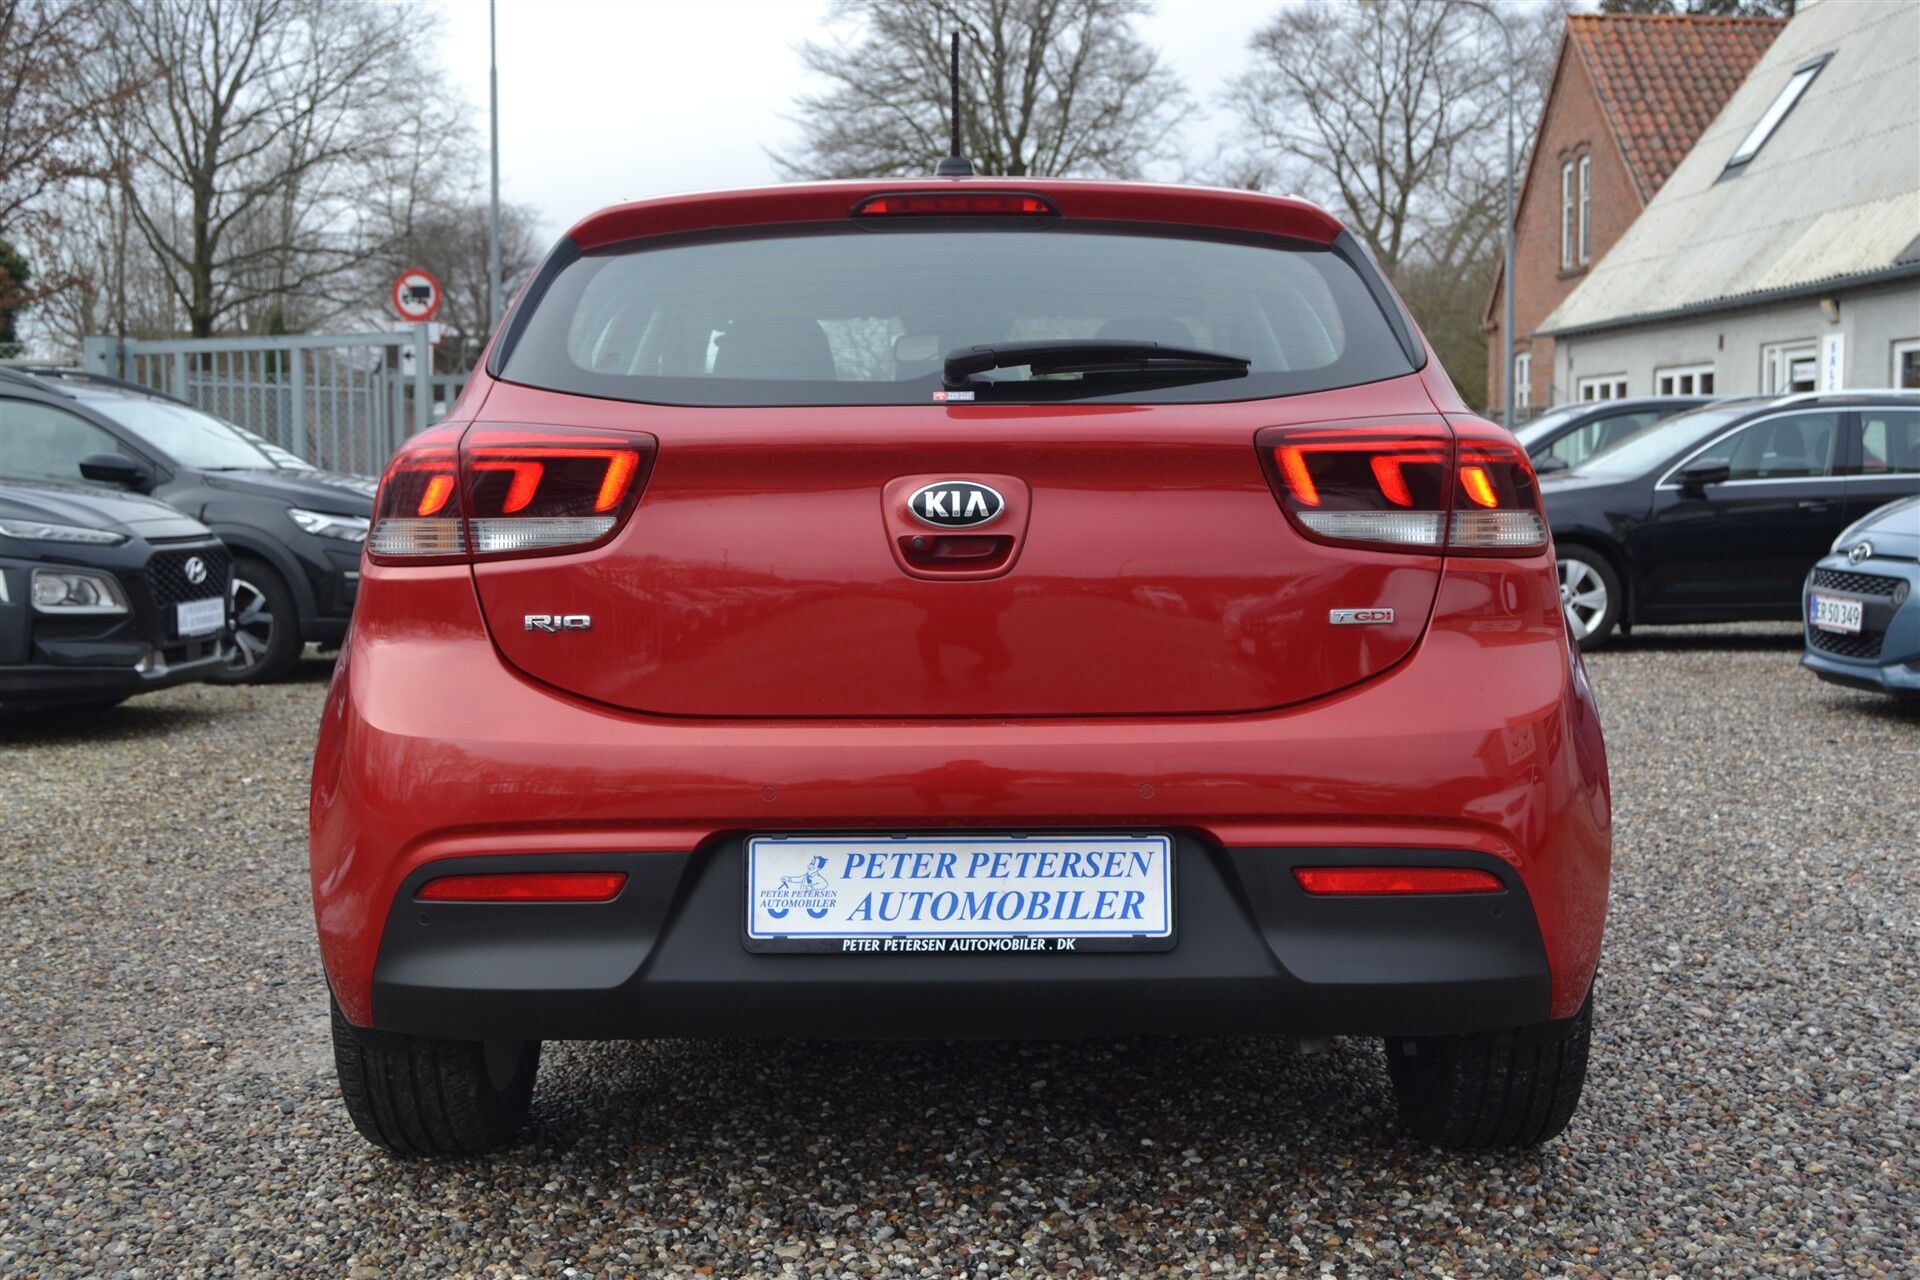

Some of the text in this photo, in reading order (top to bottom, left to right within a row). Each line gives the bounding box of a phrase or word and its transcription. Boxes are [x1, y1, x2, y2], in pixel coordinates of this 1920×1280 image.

[924, 490, 990, 518] KIA
[524, 614, 591, 632] RIO
[1816, 601, 1859, 626] ER 50 349
[840, 851, 1155, 879] PETER PETERSEN
[760, 890, 838, 898] PETER PETERSEN
[760, 899, 837, 907] AUTOMOBILER
[846, 890, 1145, 921] AUTOMOBILER
[842, 939, 880, 951] PETER
[884, 939, 946, 951] PETERSEN
[950, 938, 1046, 951] AUTOMOBILER
